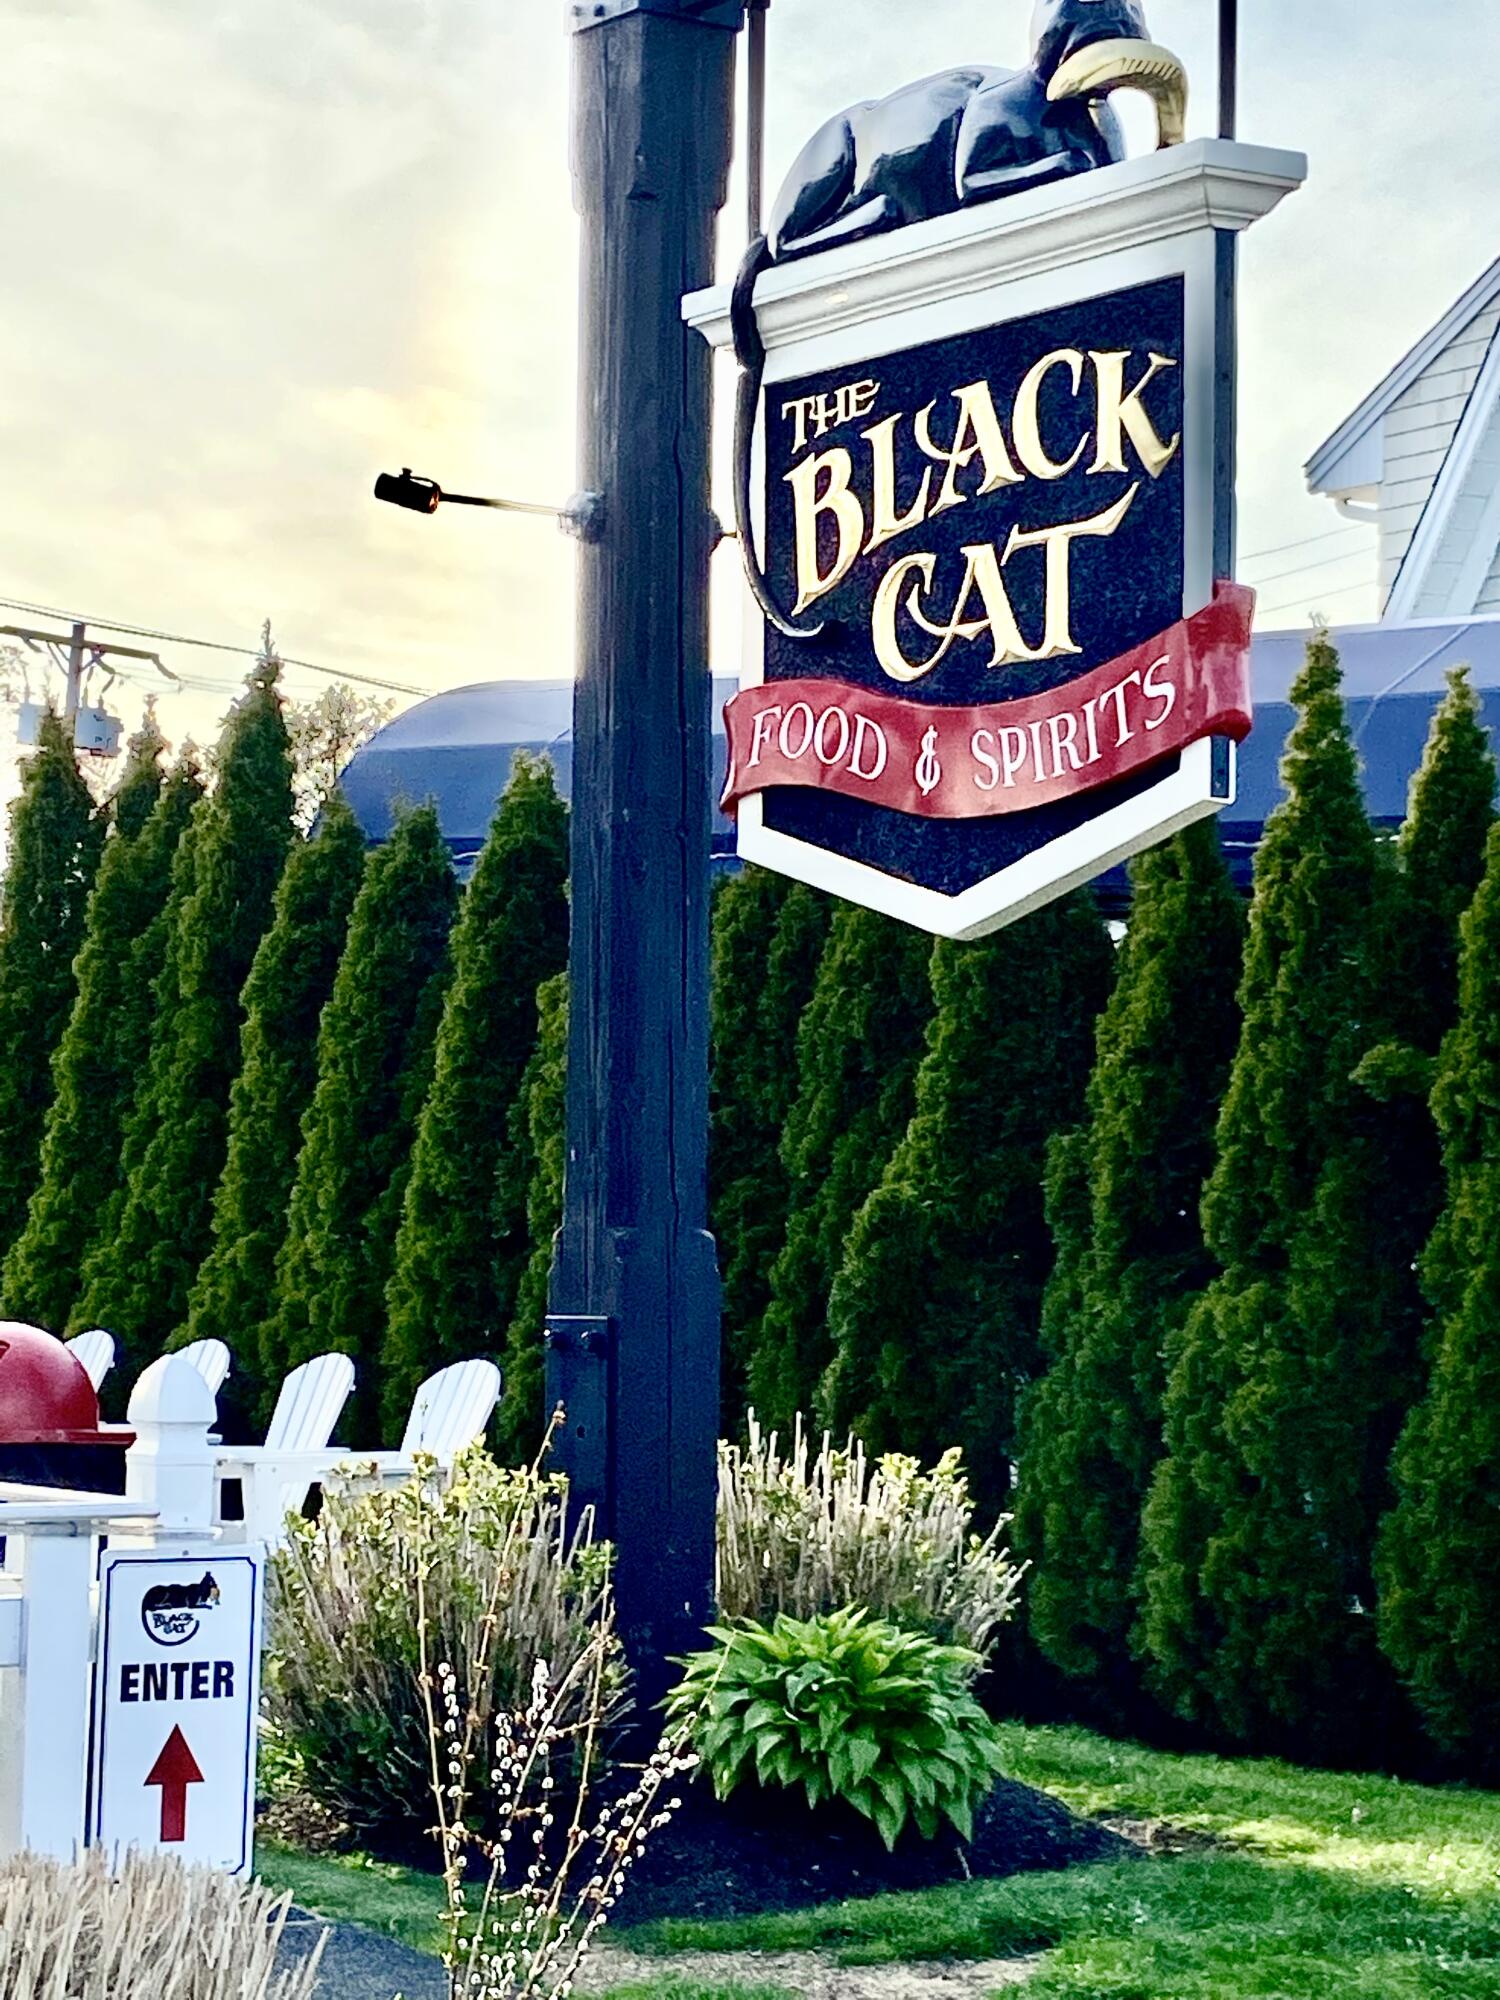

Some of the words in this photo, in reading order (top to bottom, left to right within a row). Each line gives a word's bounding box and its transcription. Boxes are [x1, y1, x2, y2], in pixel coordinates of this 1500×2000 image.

[782, 380, 880, 453] THE
[782, 349, 1179, 615] BLACK
[872, 482, 1139, 682] CAT
[747, 703, 886, 779] FOOD
[972, 655, 1175, 788] SPIRITS
[120, 1661, 234, 1702] ENTER
